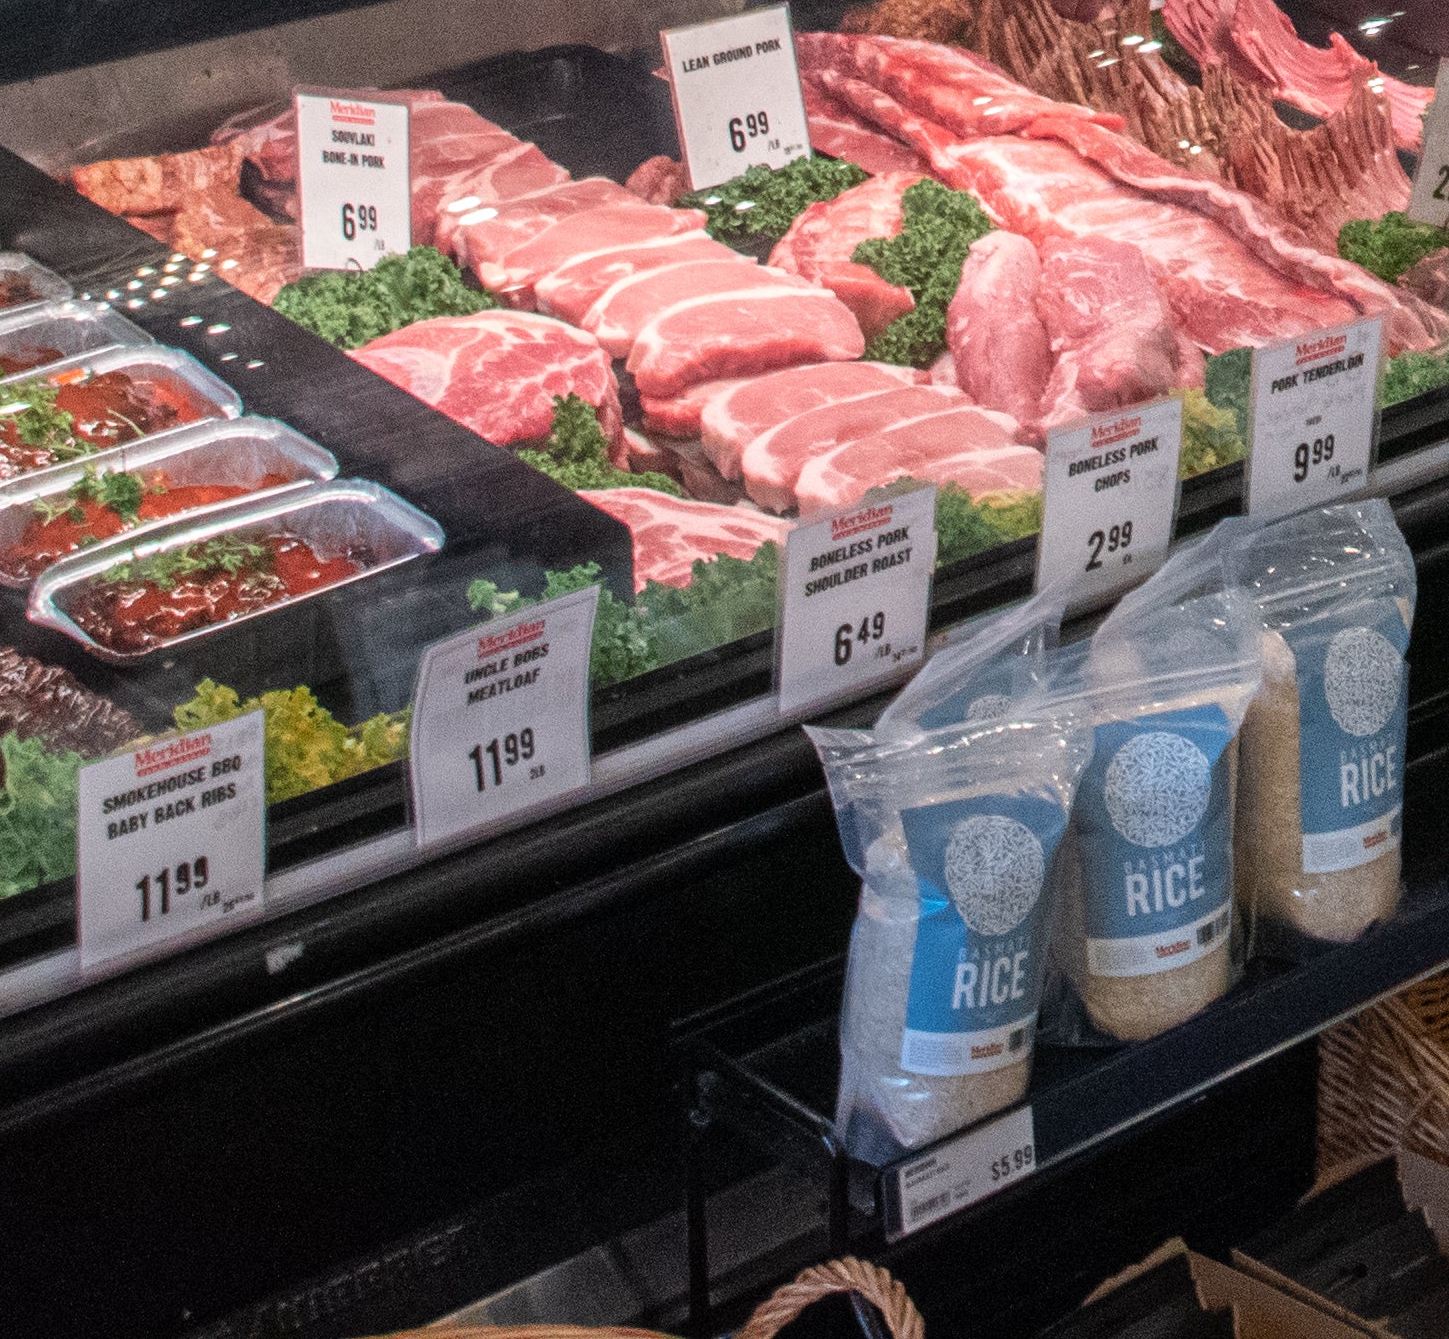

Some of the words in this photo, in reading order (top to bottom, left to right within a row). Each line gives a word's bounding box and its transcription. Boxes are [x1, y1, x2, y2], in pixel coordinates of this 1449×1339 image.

[681, 54, 709, 73] LEAN
[712, 44, 752, 67] GROUND
[754, 36, 784, 57] PORK
[330, 127, 377, 148] SOUVLAKI
[361, 153, 387, 169] PORK
[1067, 448, 1126, 478] BONELESS
[1128, 437, 1160, 459] PORK
[1093, 468, 1132, 495] CHOPS
[808, 538, 874, 573] BONELESS
[875, 526, 910, 552] PORK
[803, 565, 870, 599] SHOULDER
[871, 547, 913, 577] ROAST
[463, 655, 510, 685] UNCLE
[466, 668, 543, 707] MEATLOAF
[101, 768, 208, 816] SMOKEHOUSE
[210, 755, 243, 783] BBQ
[1340, 746, 1399, 809] RICE
[106, 812, 149, 842] BABY
[152, 796, 195, 829] BACK
[199, 780, 238, 811] RIBS
[1124, 853, 1208, 918] RICE
[951, 948, 1029, 1012] RICE
[990, 1144, 1034, 1182] $5.99
